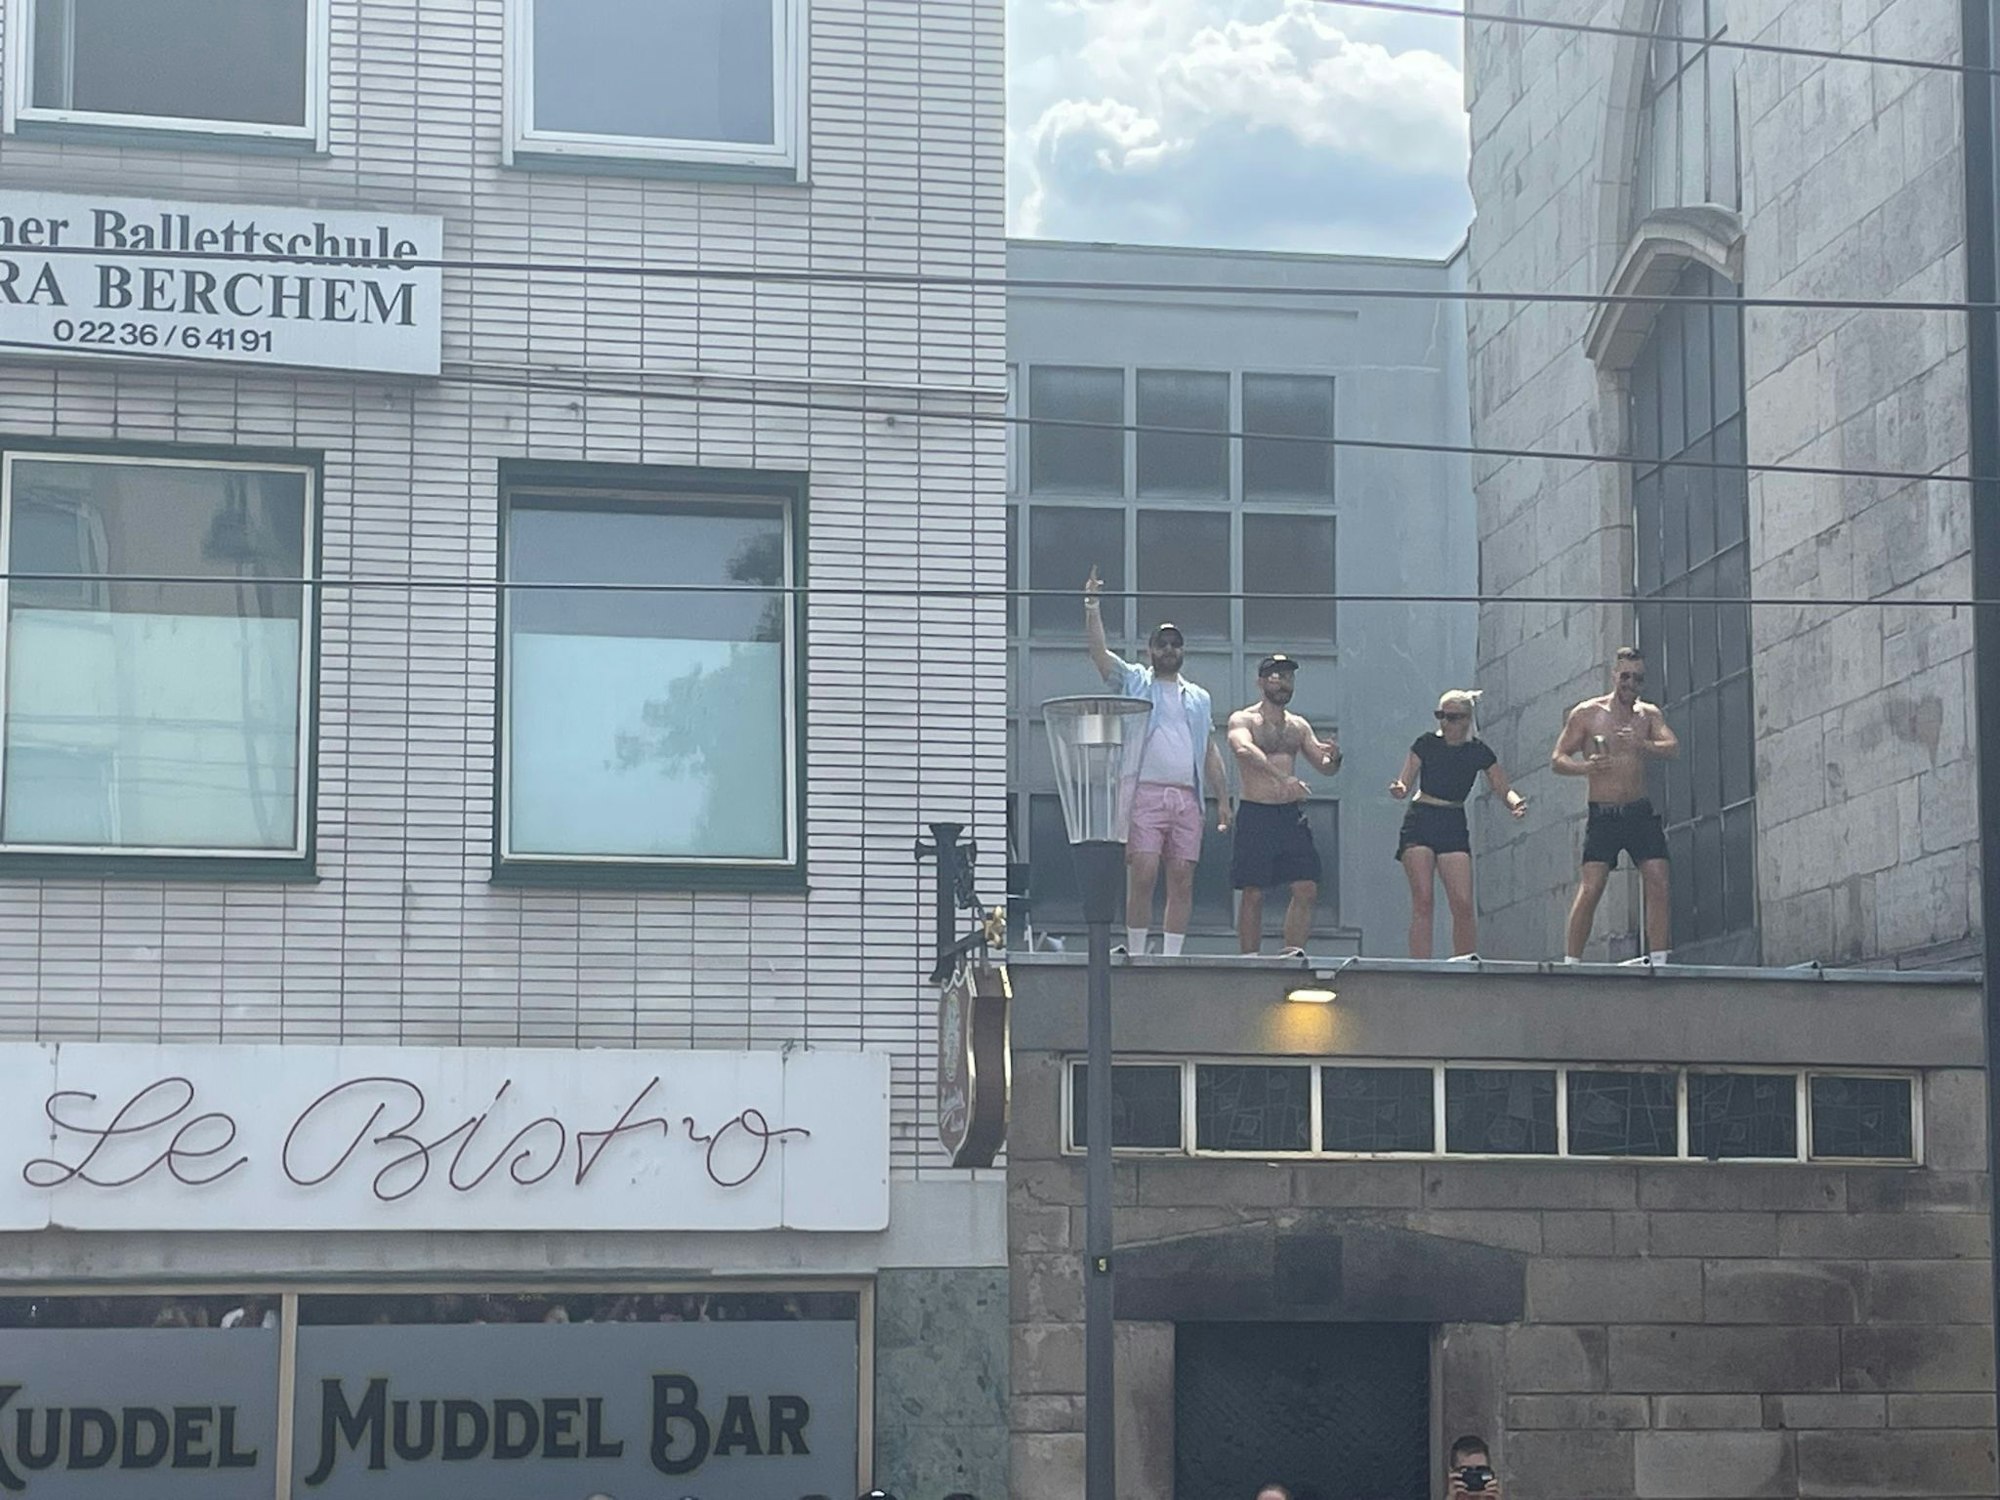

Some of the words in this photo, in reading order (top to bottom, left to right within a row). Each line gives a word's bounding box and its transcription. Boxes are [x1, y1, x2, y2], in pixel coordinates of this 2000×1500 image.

[90, 208, 418, 270] Ballettschule
[93, 264, 417, 326] BERCHEM
[53, 319, 273, 352] 02236/64191
[23, 1077, 247, 1187] Le
[283, 1077, 809, 1200] Bistro
[304, 1377, 625, 1487] MUDDEL
[650, 1373, 811, 1476] BAR
